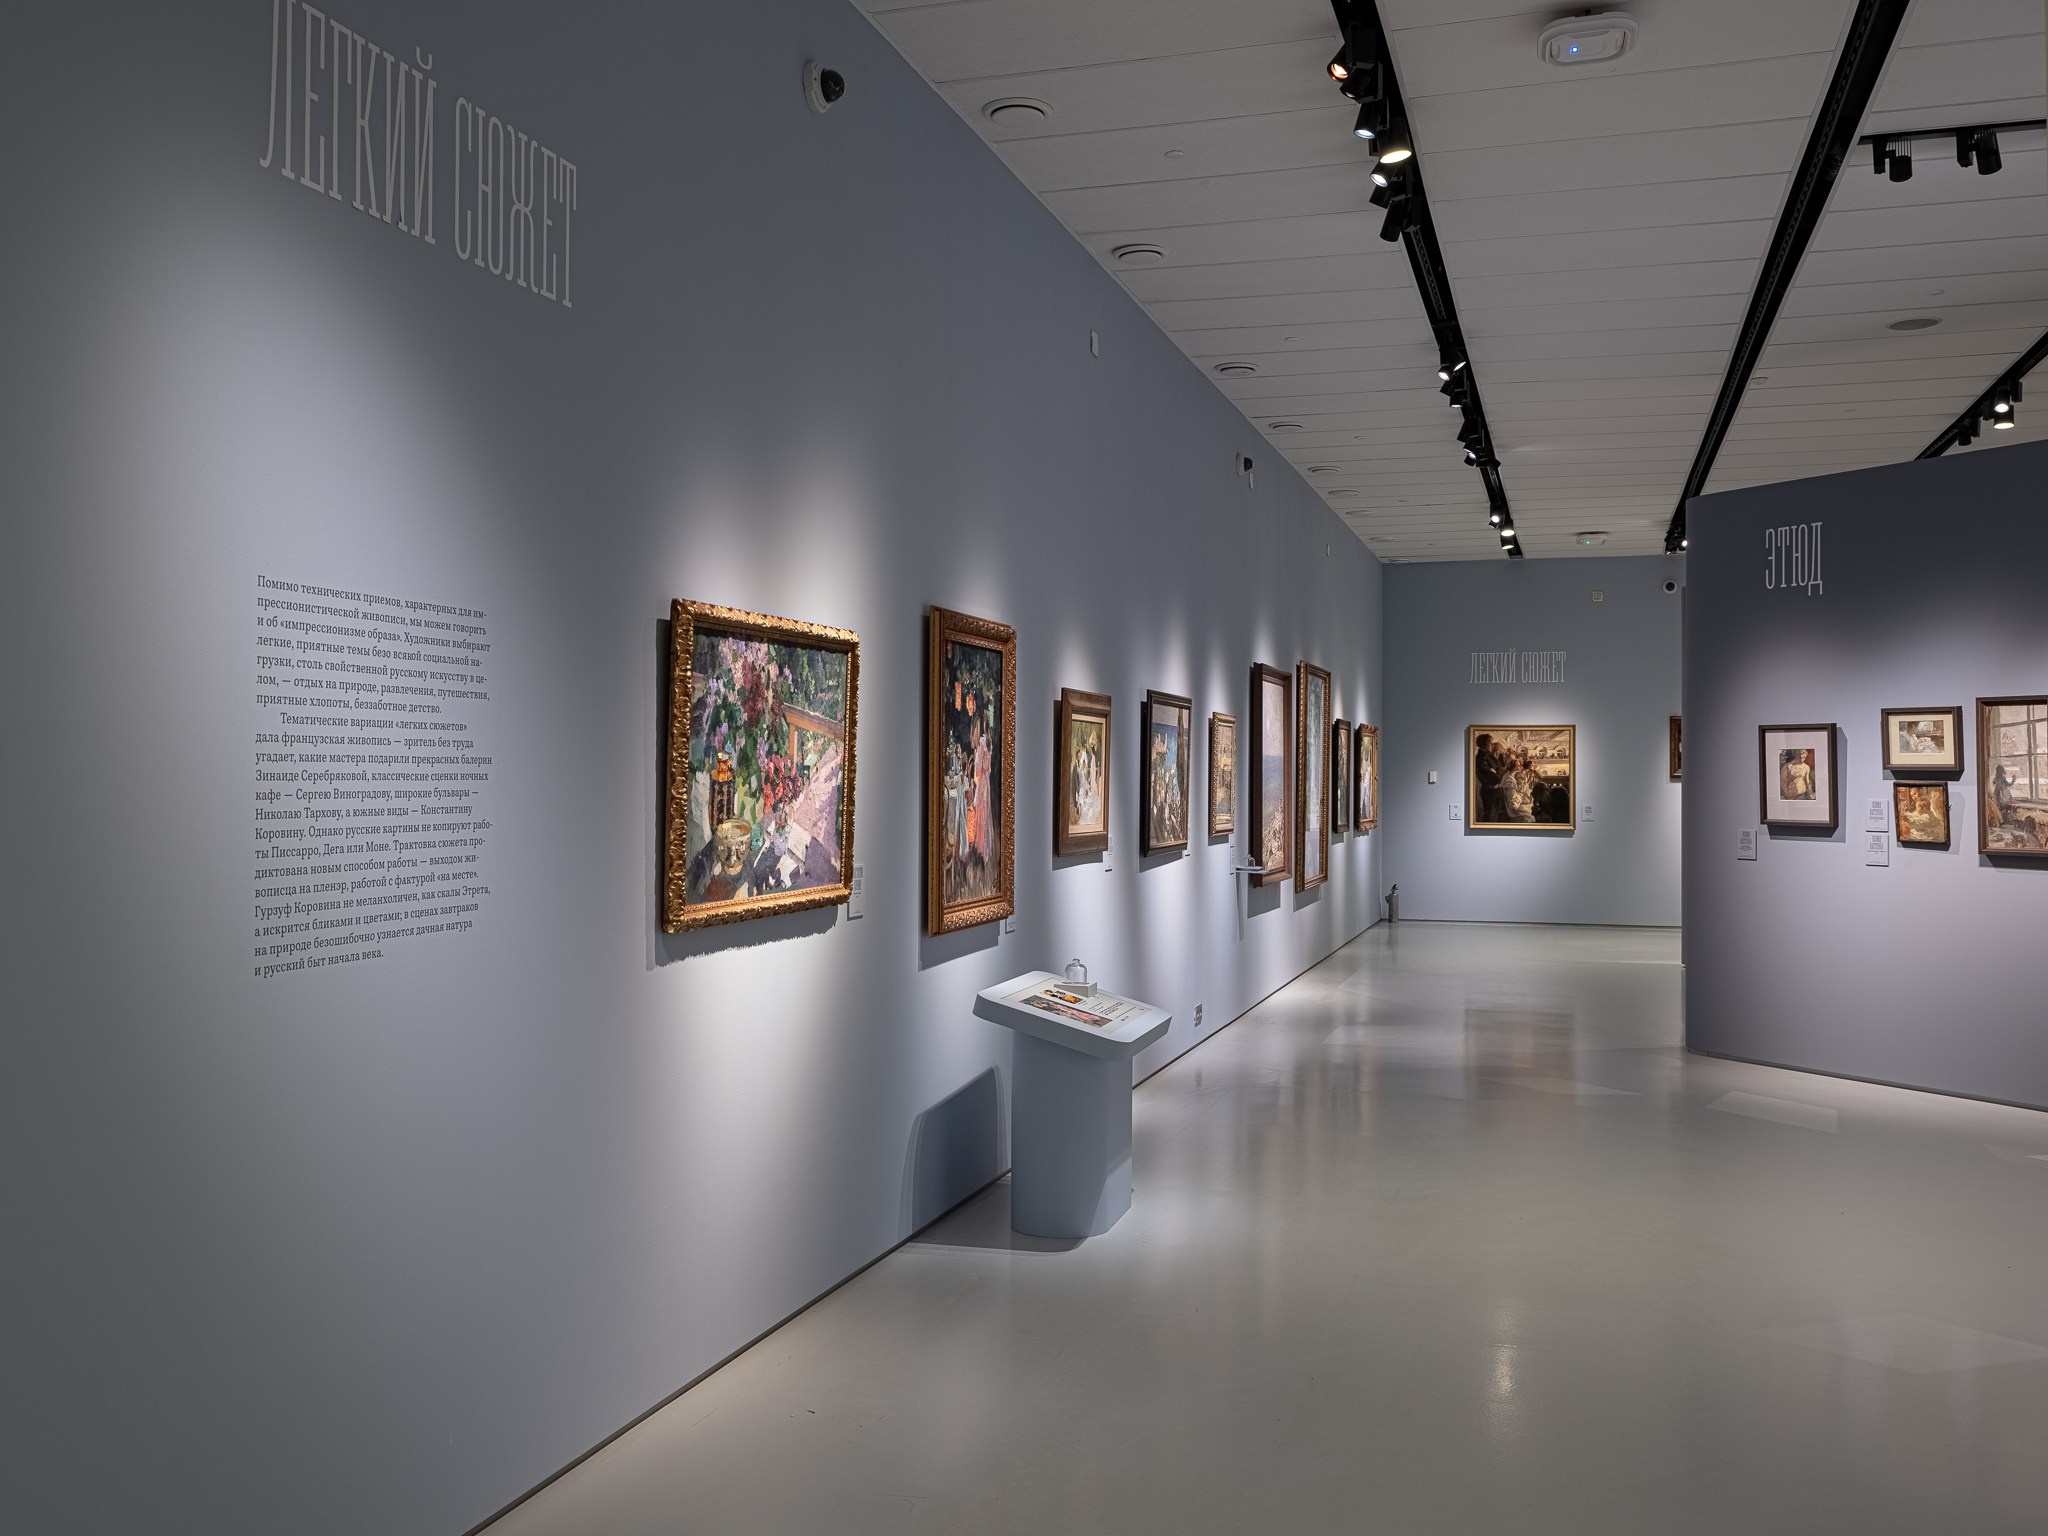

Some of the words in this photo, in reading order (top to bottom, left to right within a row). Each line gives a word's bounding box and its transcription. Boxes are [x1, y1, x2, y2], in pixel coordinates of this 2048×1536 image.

[259, 0, 437, 245] ЛЕГКИЙ
[454, 96, 577, 308] СЮЖЕТ
[1765, 521, 1823, 596] ЭТЮД
[257, 574, 299, 593] Помимо
[300, 584, 362, 602] технических
[362, 593, 403, 610] приемов,
[404, 600, 457, 616] характерных
[457, 607, 472, 618] для
[257, 597, 360, 620] прессионистической
[361, 611, 409, 628] живописи,
[409, 618, 423, 628] мы
[423, 619, 452, 631] можем
[452, 623, 487, 637] говорить
[257, 616, 264, 626] и
[266, 615, 279, 628] об
[403, 631, 451, 648] Художники
[451, 638, 491, 654] выбирают
[256, 636, 295, 651] легкие,
[296, 640, 345, 654] приятные
[346, 645, 371, 657] темы
[371, 645, 391, 659] безо
[391, 650, 422, 662] всякой
[422, 653, 470, 666] социальной
[1469, 647, 1517, 684] ЛЕГКИЙ
[1521, 651, 1567, 683] СЮЖЕТ
[256, 655, 295, 670] грузки,
[296, 659, 324, 670] столь
[324, 660, 389, 676] свойственной
[389, 666, 429, 682] русскому
[429, 671, 469, 685] искусству
[469, 674, 475, 683] в
[256, 675, 279, 688] лом,
[293, 677, 324, 690] отдых
[325, 680, 337, 690] на
[338, 681, 380, 696] природе,
[380, 684, 437, 699] развлечения,
[437, 688, 490, 702] путешествия,
[256, 694, 308, 708] приятные
[309, 697, 353, 711] хлопоты,
[354, 697, 408, 712] беззаботное
[407, 703, 442, 714] детство.
[279, 711, 349, 727] Тематические
[350, 718, 394, 731] вариации
[254, 733, 280, 745] дала
[281, 731, 346, 748] французская
[346, 736, 392, 746] живопись
[403, 738, 437, 750] зритель
[437, 736, 451, 748] без
[451, 739, 474, 751] труда
[255, 752, 297, 766] угадает,
[298, 753, 328, 763] какие
[328, 754, 367, 767] мастера
[367, 754, 410, 767] подарили
[411, 755, 460, 768] прекрасных
[460, 753, 493, 768] балерин
[255, 769, 300, 784] Зинаиде
[300, 768, 370, 785] Серебряковой,
[371, 772, 430, 782] классические
[430, 772, 459, 783] сценки
[459, 772, 489, 781] ночных
[255, 788, 282, 805] кафе
[295, 788, 332, 804] Сергею
[332, 787, 393, 803] Виноградову,
[394, 790, 433, 802] широкие
[433, 786, 470, 801] бульвары
[254, 808, 302, 821] Николаю
[303, 806, 344, 822] Тархову,
[345, 808, 351, 818] а
[352, 807, 386, 818] южные
[386, 807, 409, 818] виды
[420, 804, 473, 817] Константину
[254, 827, 307, 843] Коровину.
[308, 825, 344, 839] Однако
[345, 825, 382, 840] русские
[382, 824, 420, 837] картины
[421, 823, 432, 832] не
[432, 822, 472, 834] копируют
[254, 849, 270, 859] ты
[271, 846, 322, 861] Писсарро,
[322, 843, 345, 858] Дега
[346, 844, 364, 854] или
[365, 840, 392, 853] Моне.
[392, 839, 437, 855] Трактовка
[437, 838, 468, 848] сюжета
[254, 866, 309, 881] диктована
[310, 863, 342, 875] новым
[343, 858, 386, 872] способом
[386, 856, 418, 873] работы
[429, 855, 463, 866] выходом
[254, 885, 297, 899] вописца
[298, 884, 312, 895] на
[313, 881, 349, 895] пленэр,
[350, 875, 387, 894] работой
[388, 877, 394, 886] с
[394, 871, 436, 889] фактурой
[254, 902, 293, 921] Гурзуф
[293, 900, 342, 916] Коровина
[342, 899, 355, 909] не
[355, 892, 420, 907] меланхоличен,
[421, 891, 436, 900] как
[436, 888, 461, 899] скалы
[461, 885, 491, 899] Этрета,
[254, 928, 261, 937] а
[262, 921, 310, 938] искрится
[311, 917, 354, 931] бликами
[355, 916, 362, 926] и
[363, 911, 403, 926] цветами;
[403, 911, 409, 920] в
[410, 907, 439, 920] сценах
[439, 903, 479, 917] завтраков
[254, 946, 268, 957] на
[269, 941, 312, 958] природе
[313, 931, 376, 949] безошибочно
[376, 927, 415, 944] узнается
[415, 923, 445, 937] дачная
[445, 920, 473, 933] натура
[254, 966, 262, 977] и
[263, 957, 306, 979] русский
[307, 955, 327, 969] быт
[327, 952, 361, 966] начала
[361, 949, 384, 961] века.
